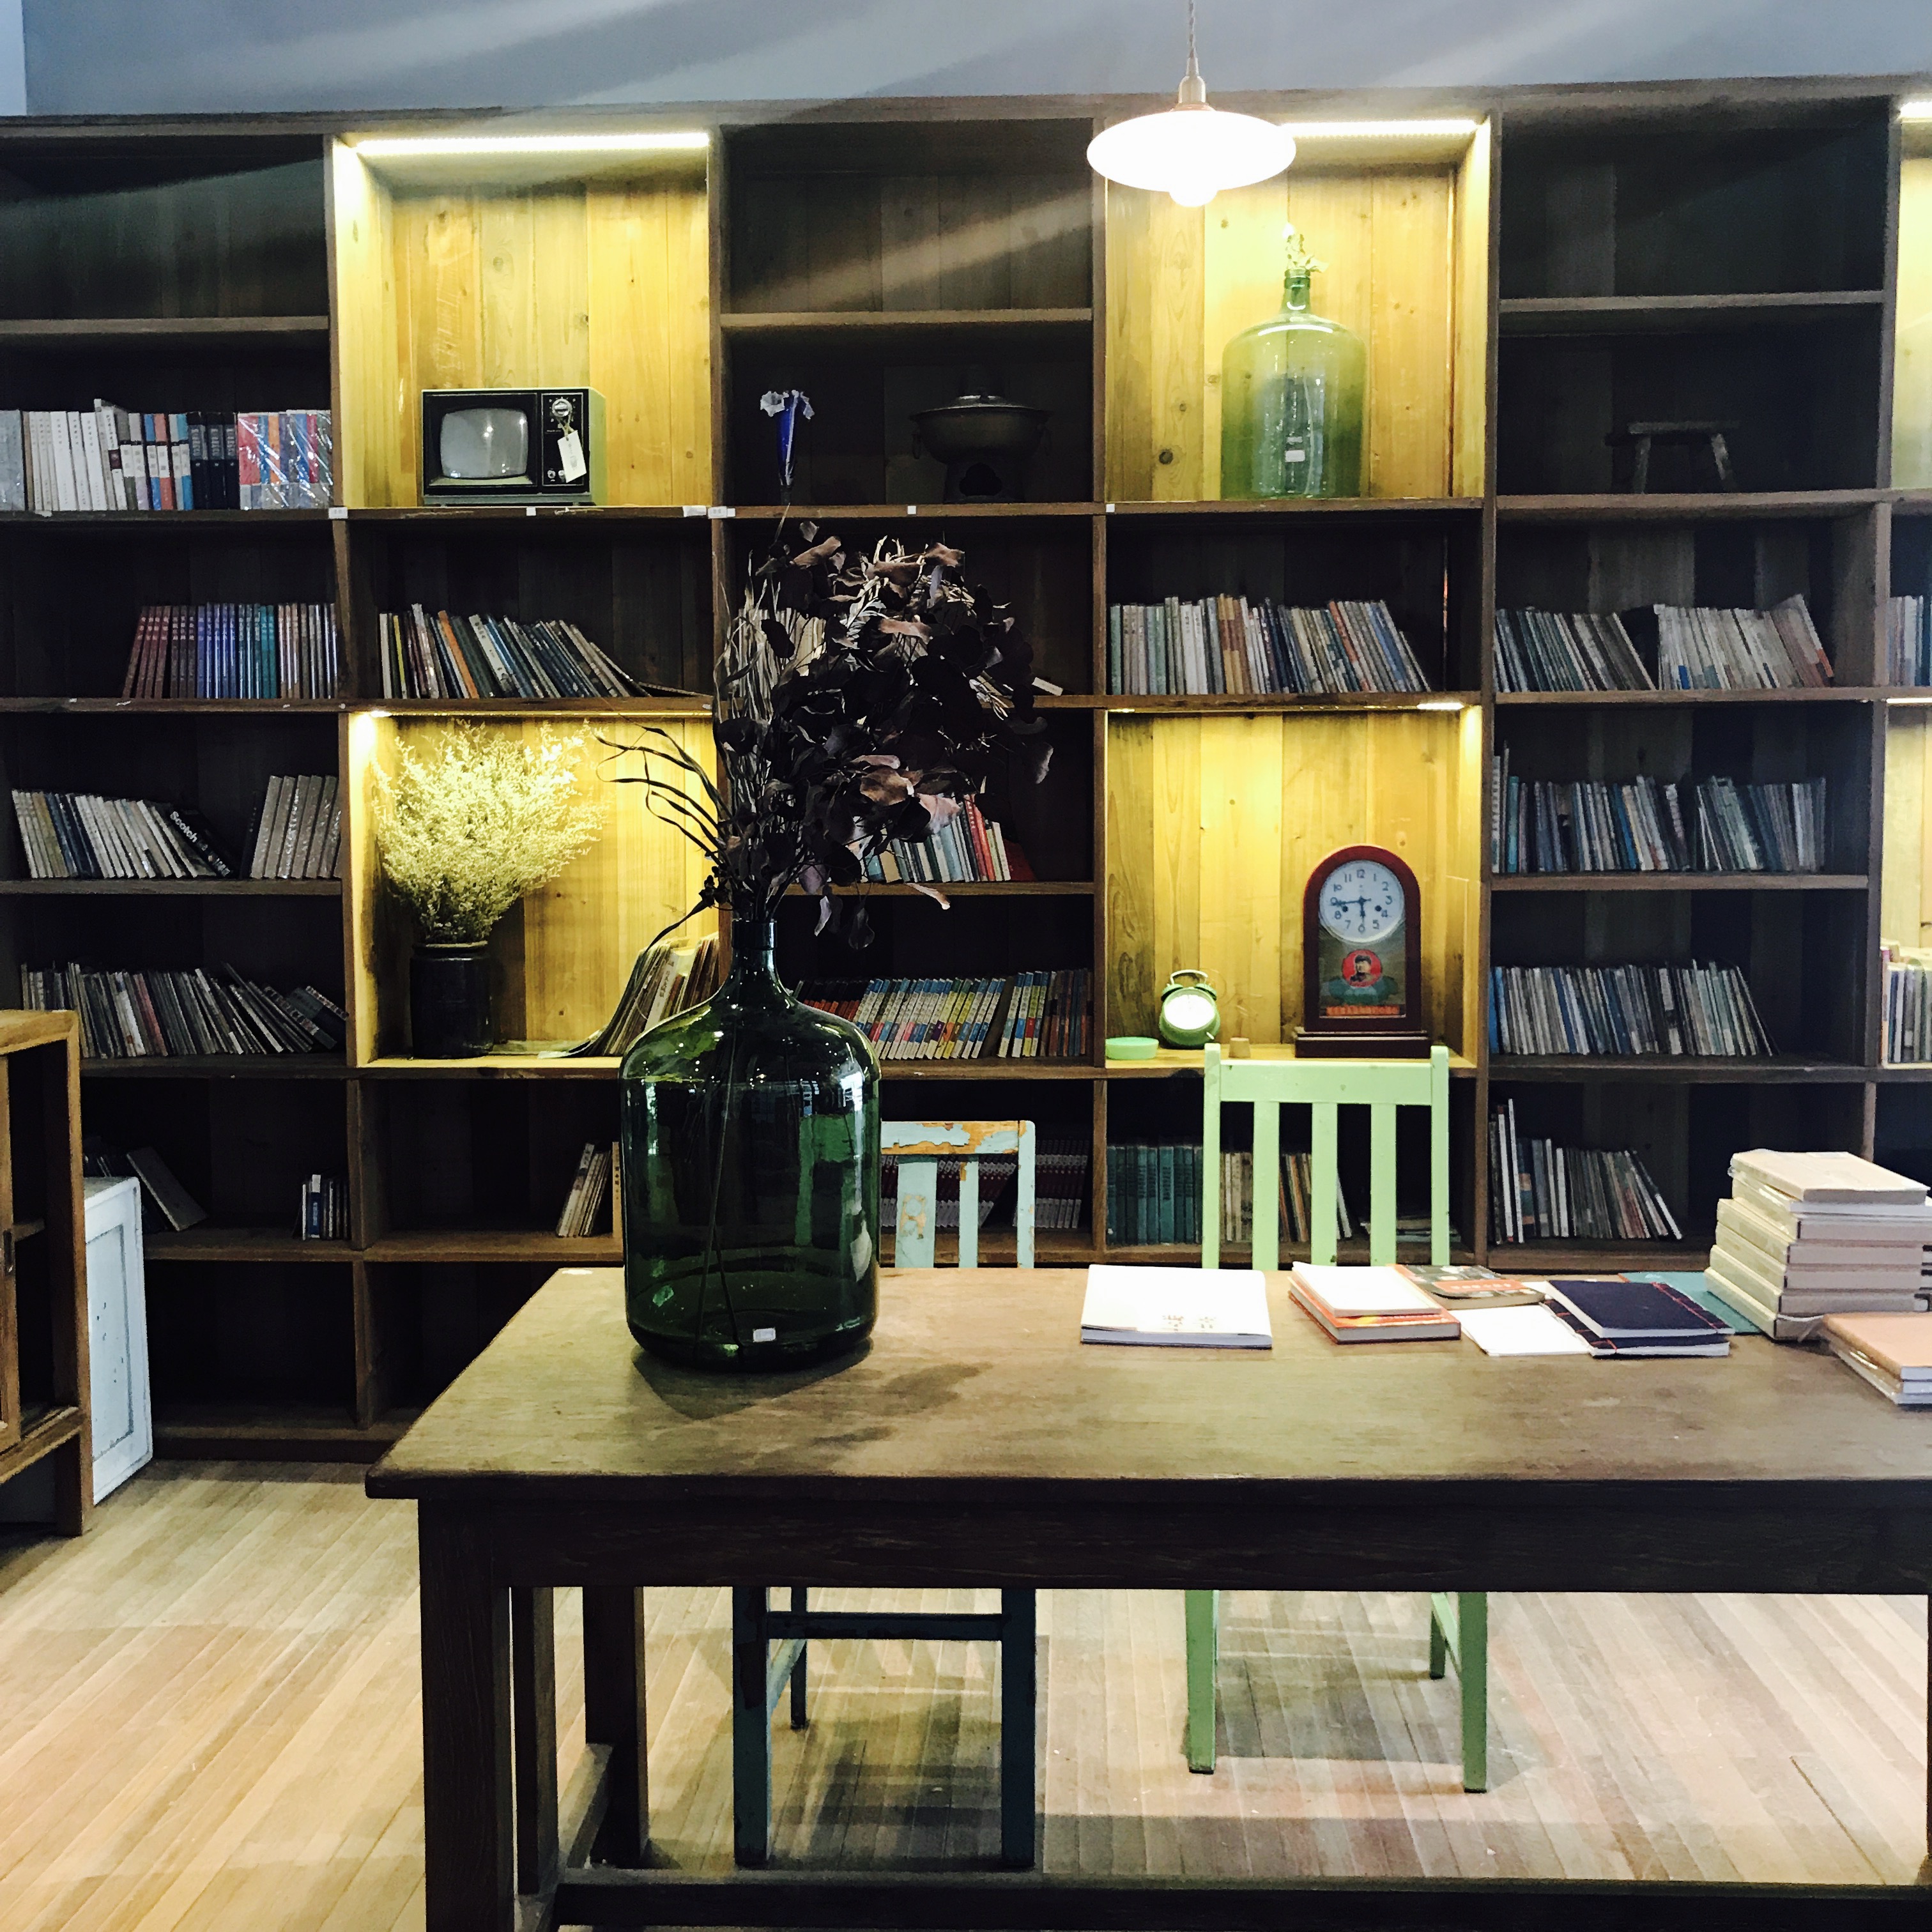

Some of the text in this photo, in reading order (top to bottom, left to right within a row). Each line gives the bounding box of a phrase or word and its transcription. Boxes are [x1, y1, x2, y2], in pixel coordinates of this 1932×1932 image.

[170, 811, 197, 843] Scotch
[1344, 873, 1352, 883] 11
[1357, 869, 1365, 878] 12
[1373, 873, 1377, 882] 1
[1333, 884, 1342, 892] 10
[1382, 881, 1389, 891] 2
[1385, 895, 1393, 905] 3
[1334, 910, 1342, 920] 8
[1381, 910, 1388, 918] 4
[1345, 920, 1351, 929] 7
[1372, 920, 1380, 929] 5
